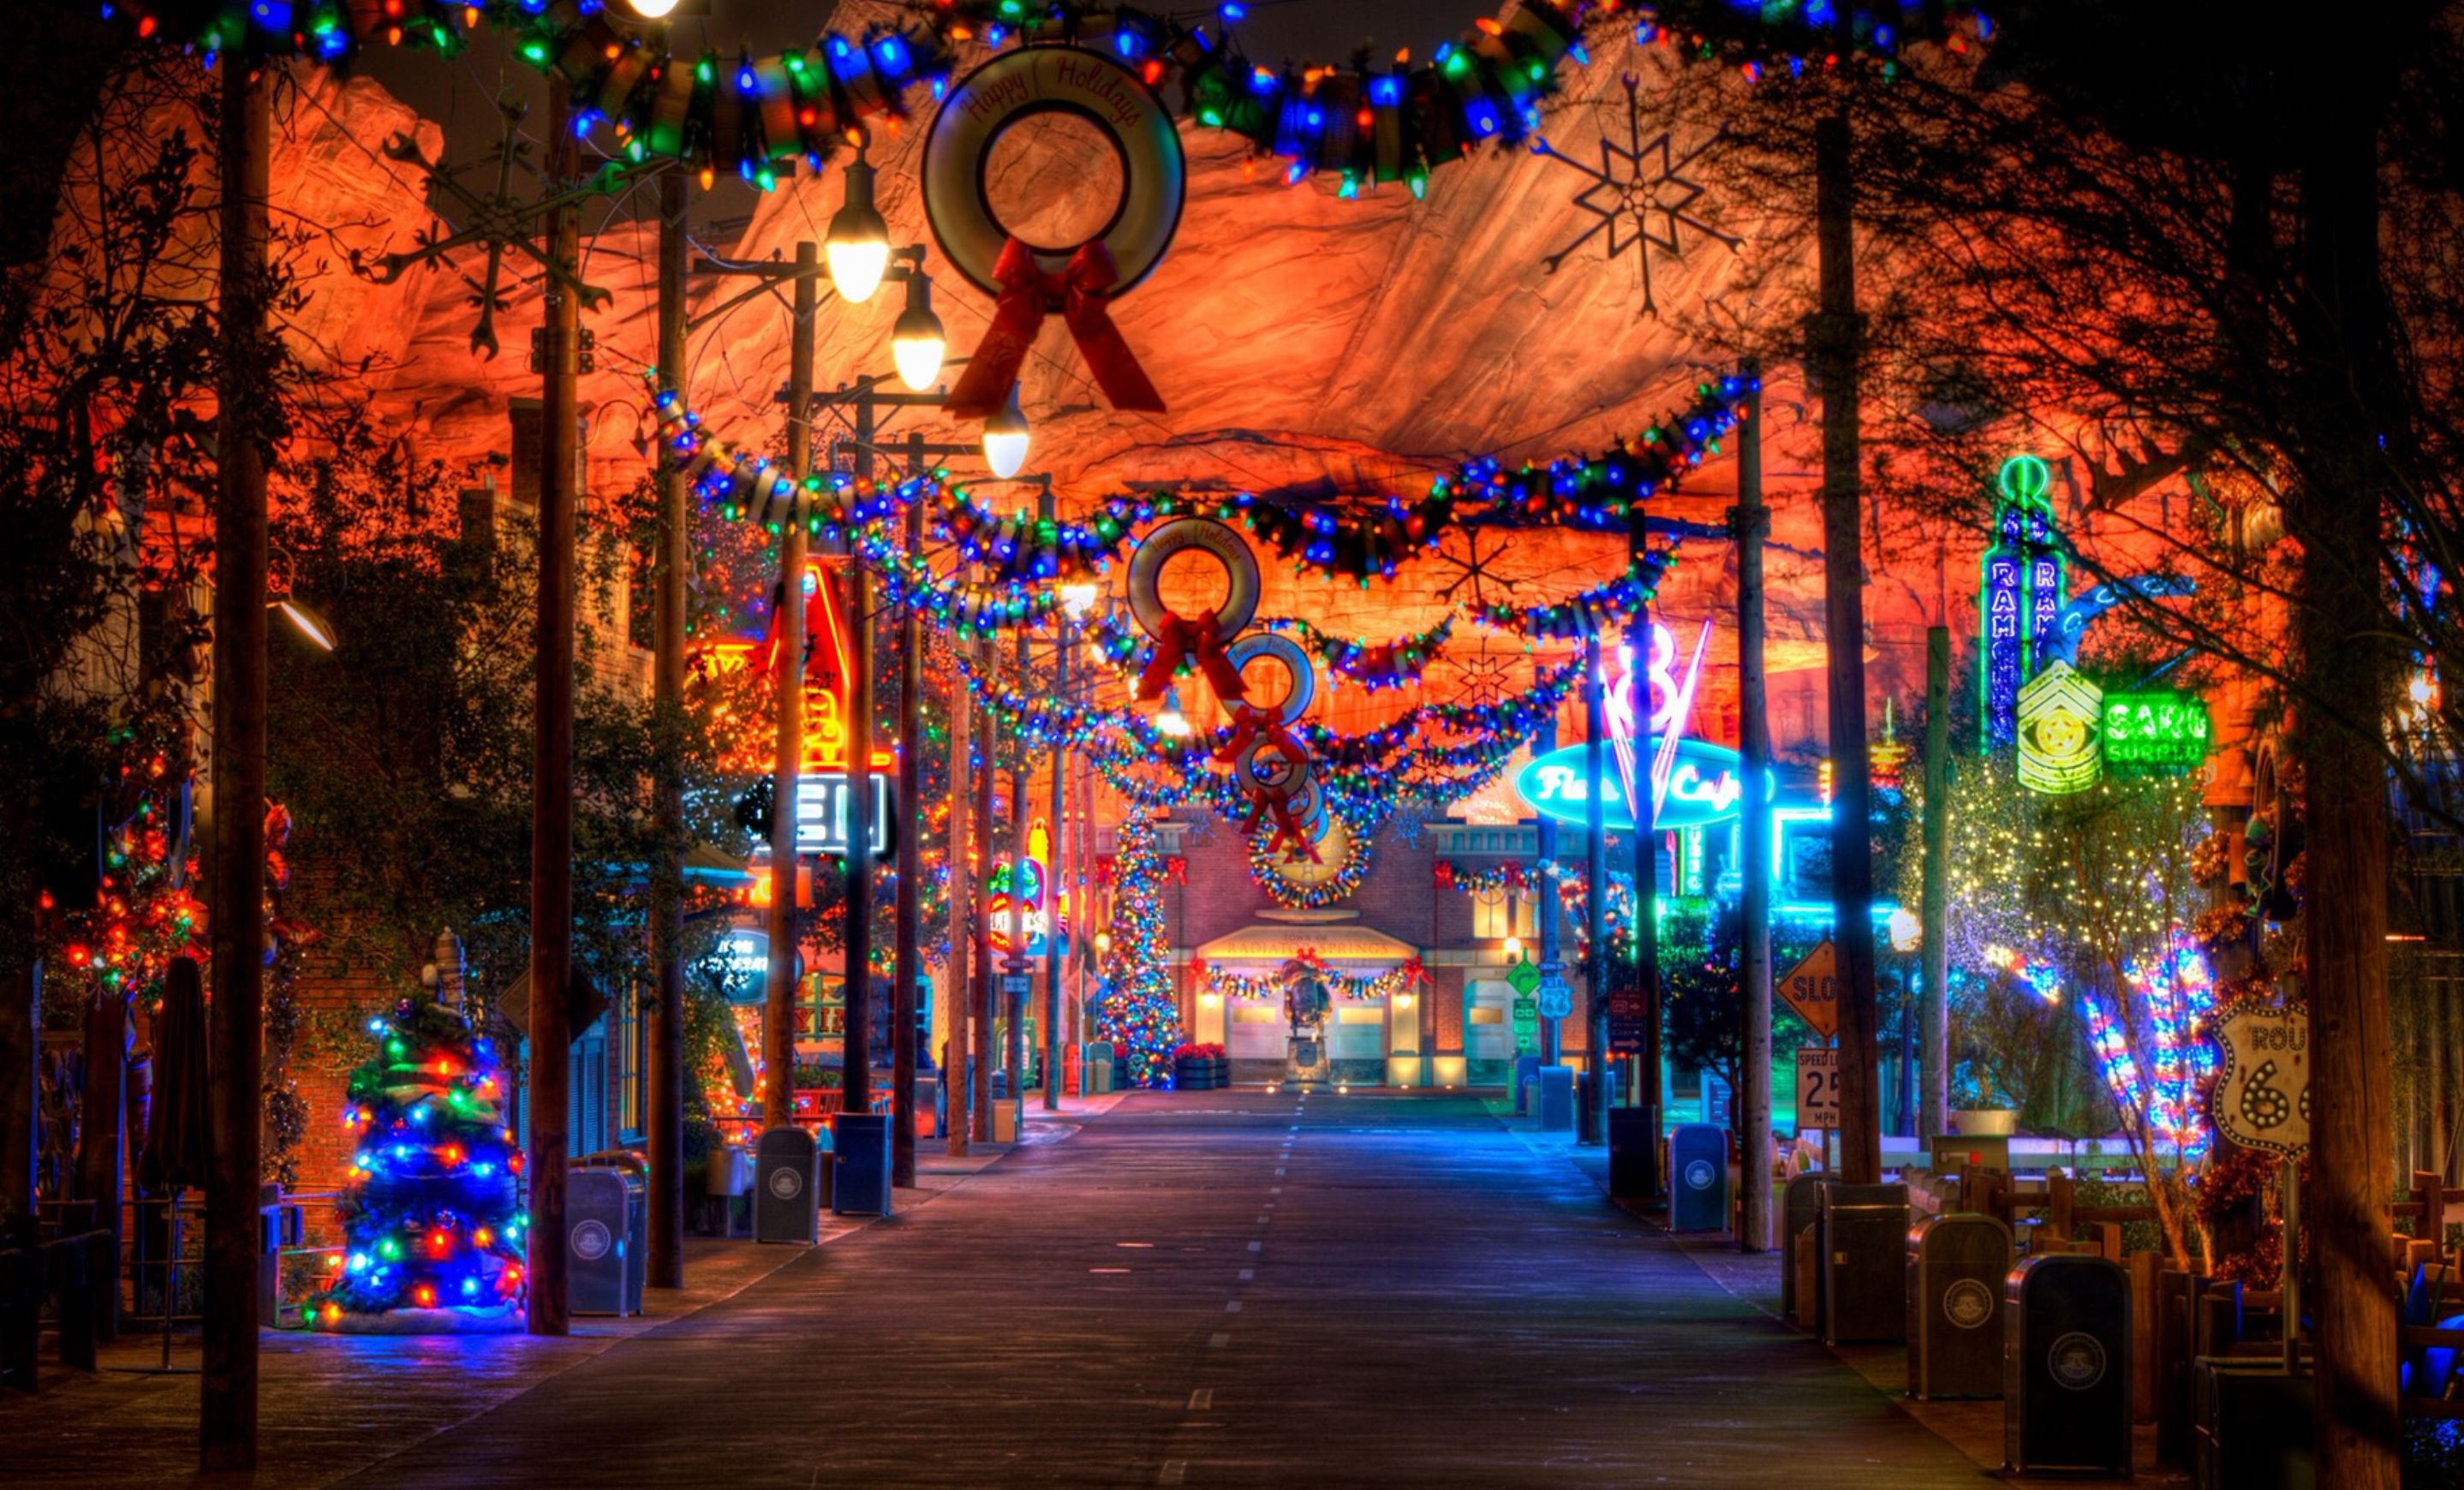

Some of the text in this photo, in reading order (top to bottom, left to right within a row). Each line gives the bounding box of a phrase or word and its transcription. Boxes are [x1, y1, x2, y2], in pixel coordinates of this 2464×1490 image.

[959, 57, 1143, 128] Happy Holidays
[2107, 704, 2206, 740] SARG
[1318, 943, 1389, 954] SPRINGS
[1793, 975, 1837, 1002] SLO
[2251, 1027, 2306, 1052] ROU
[1799, 1053, 1828, 1067] SPEED
[2240, 1059, 2310, 1129] 6
[1814, 1112, 1836, 1123] MPH
